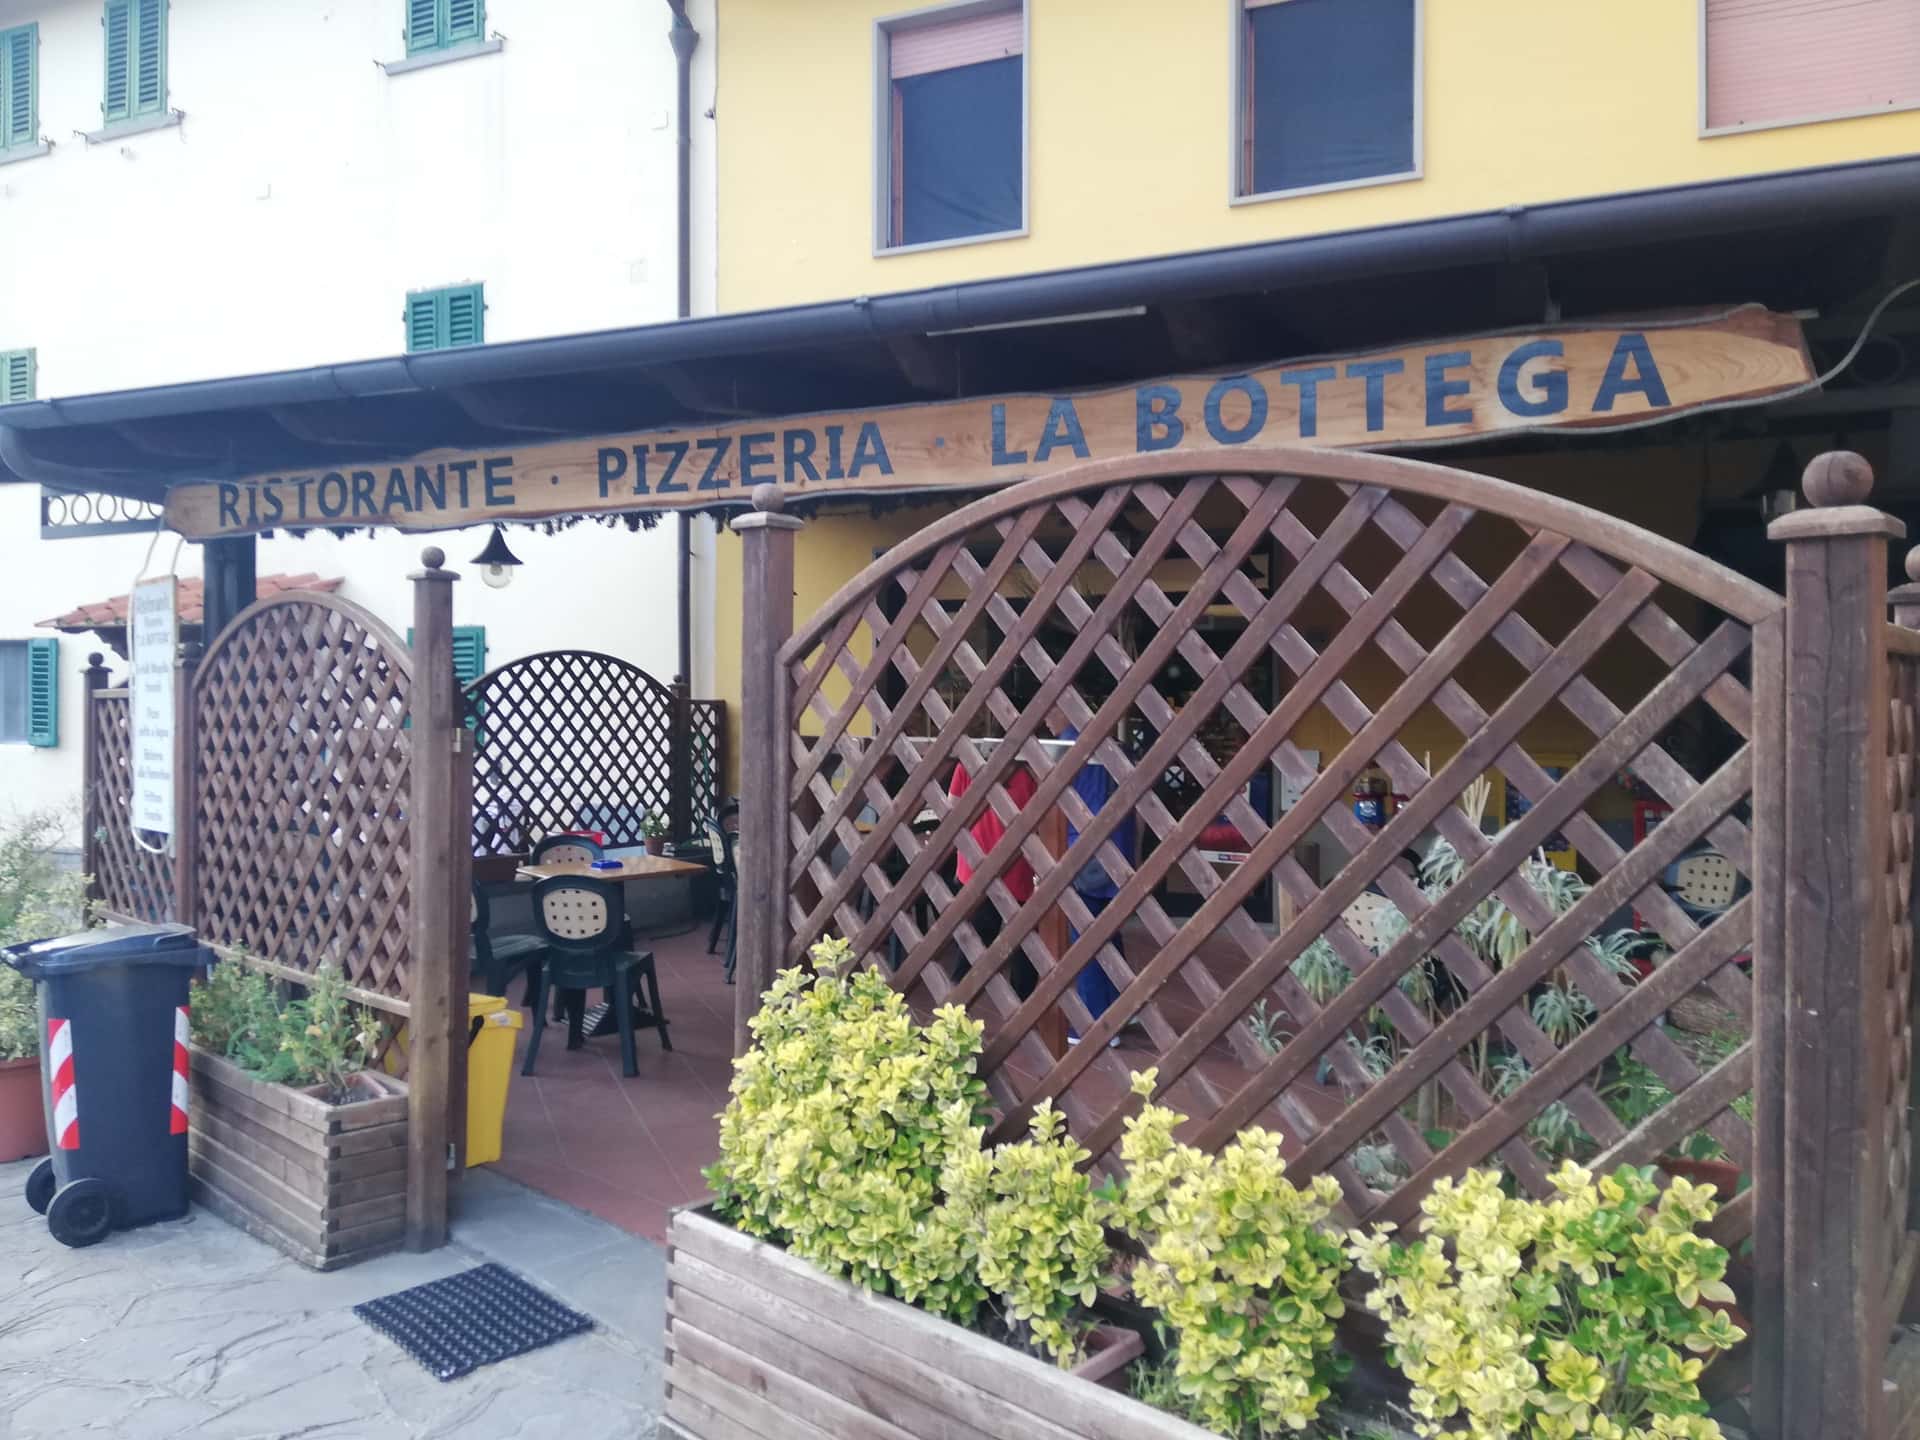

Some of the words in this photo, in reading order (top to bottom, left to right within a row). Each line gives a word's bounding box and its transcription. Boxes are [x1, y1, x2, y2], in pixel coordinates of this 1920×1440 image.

[218, 456, 516, 528] RISTORANTE
[597, 421, 895, 498] PIZZERIA
[991, 396, 1091, 467] LA
[1135, 333, 1673, 453] BOTTEGA
